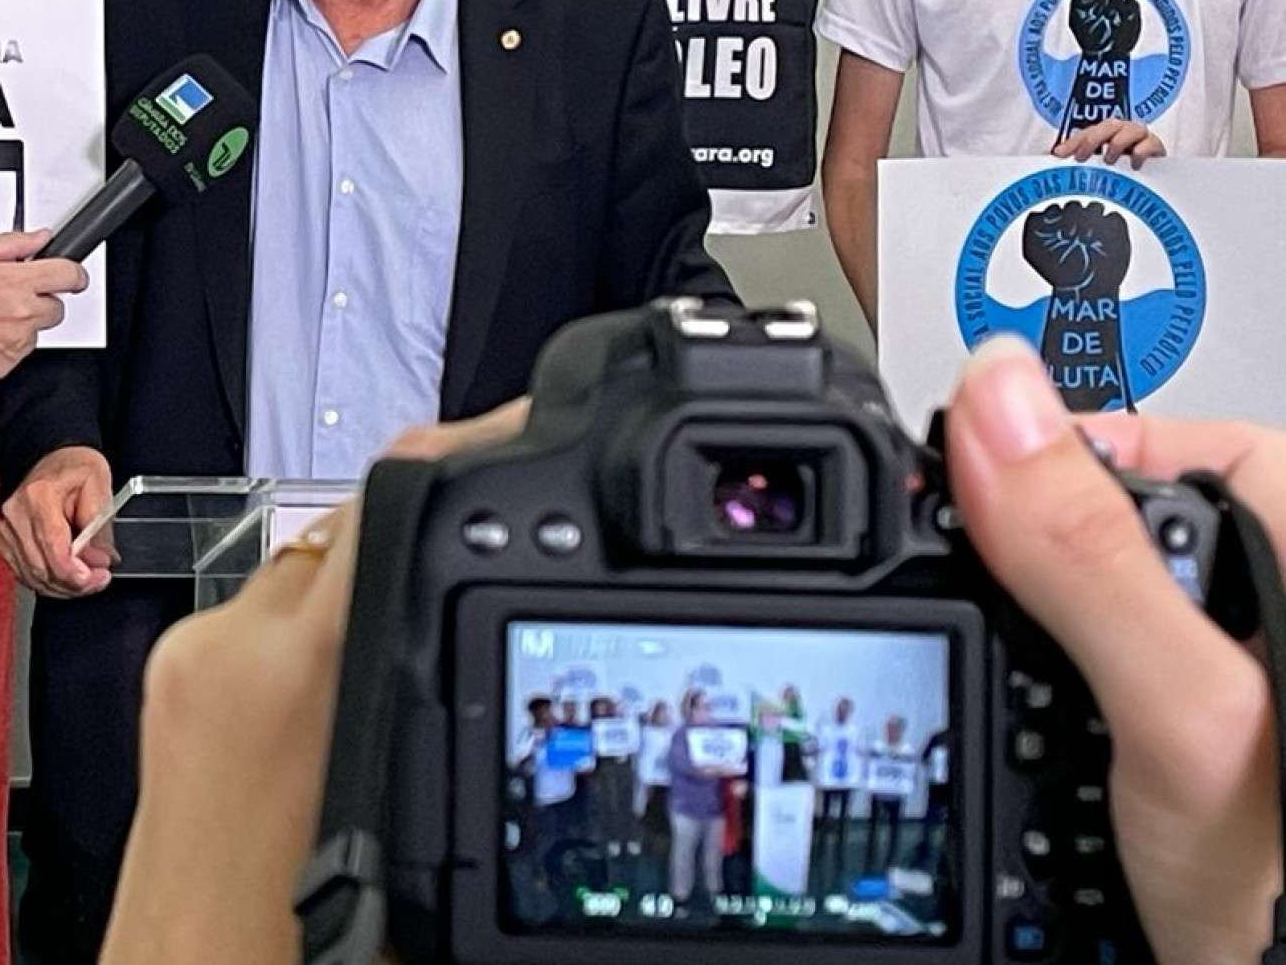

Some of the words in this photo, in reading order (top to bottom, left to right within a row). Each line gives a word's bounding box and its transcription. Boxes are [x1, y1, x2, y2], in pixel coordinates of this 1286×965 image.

[674, 29, 778, 101] LEO
[1080, 59, 1128, 77] MAR
[1085, 82, 1116, 98] DE
[1072, 103, 1124, 121] LUTA
[988, 187, 1030, 230] POVOS
[1034, 173, 1062, 199] DAS
[1068, 168, 1119, 198] ÁGUAS
[1174, 259, 1197, 299] PELO
[1052, 299, 1117, 322] MAR
[1063, 332, 1103, 354] DE
[1050, 365, 1120, 388] LUTA
